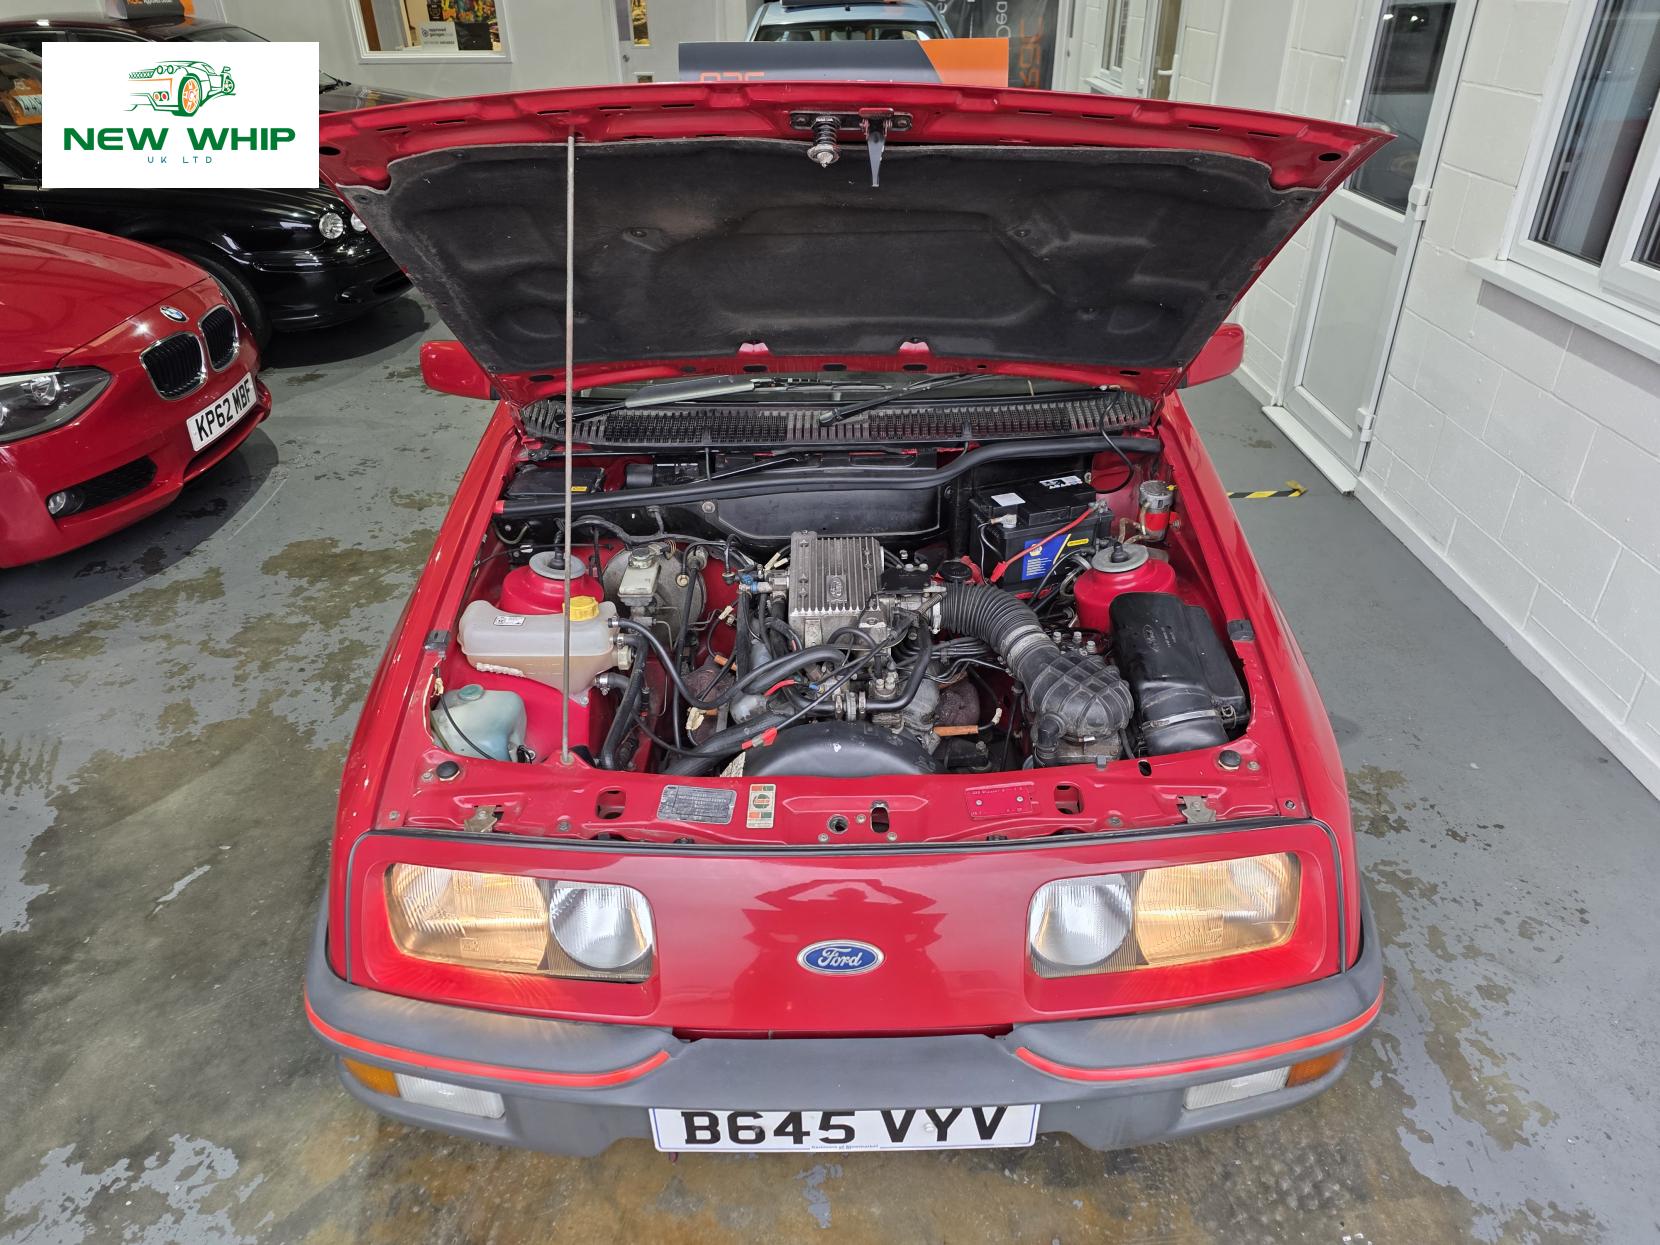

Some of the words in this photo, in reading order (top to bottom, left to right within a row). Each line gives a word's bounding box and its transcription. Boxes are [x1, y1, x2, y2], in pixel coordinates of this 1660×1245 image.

[195, 397, 234, 442] KP62
[231, 378, 251, 415] MBF
[817, 946, 863, 967] Ford
[680, 1111, 856, 1145] B645
[880, 1105, 1009, 1143] VYV
